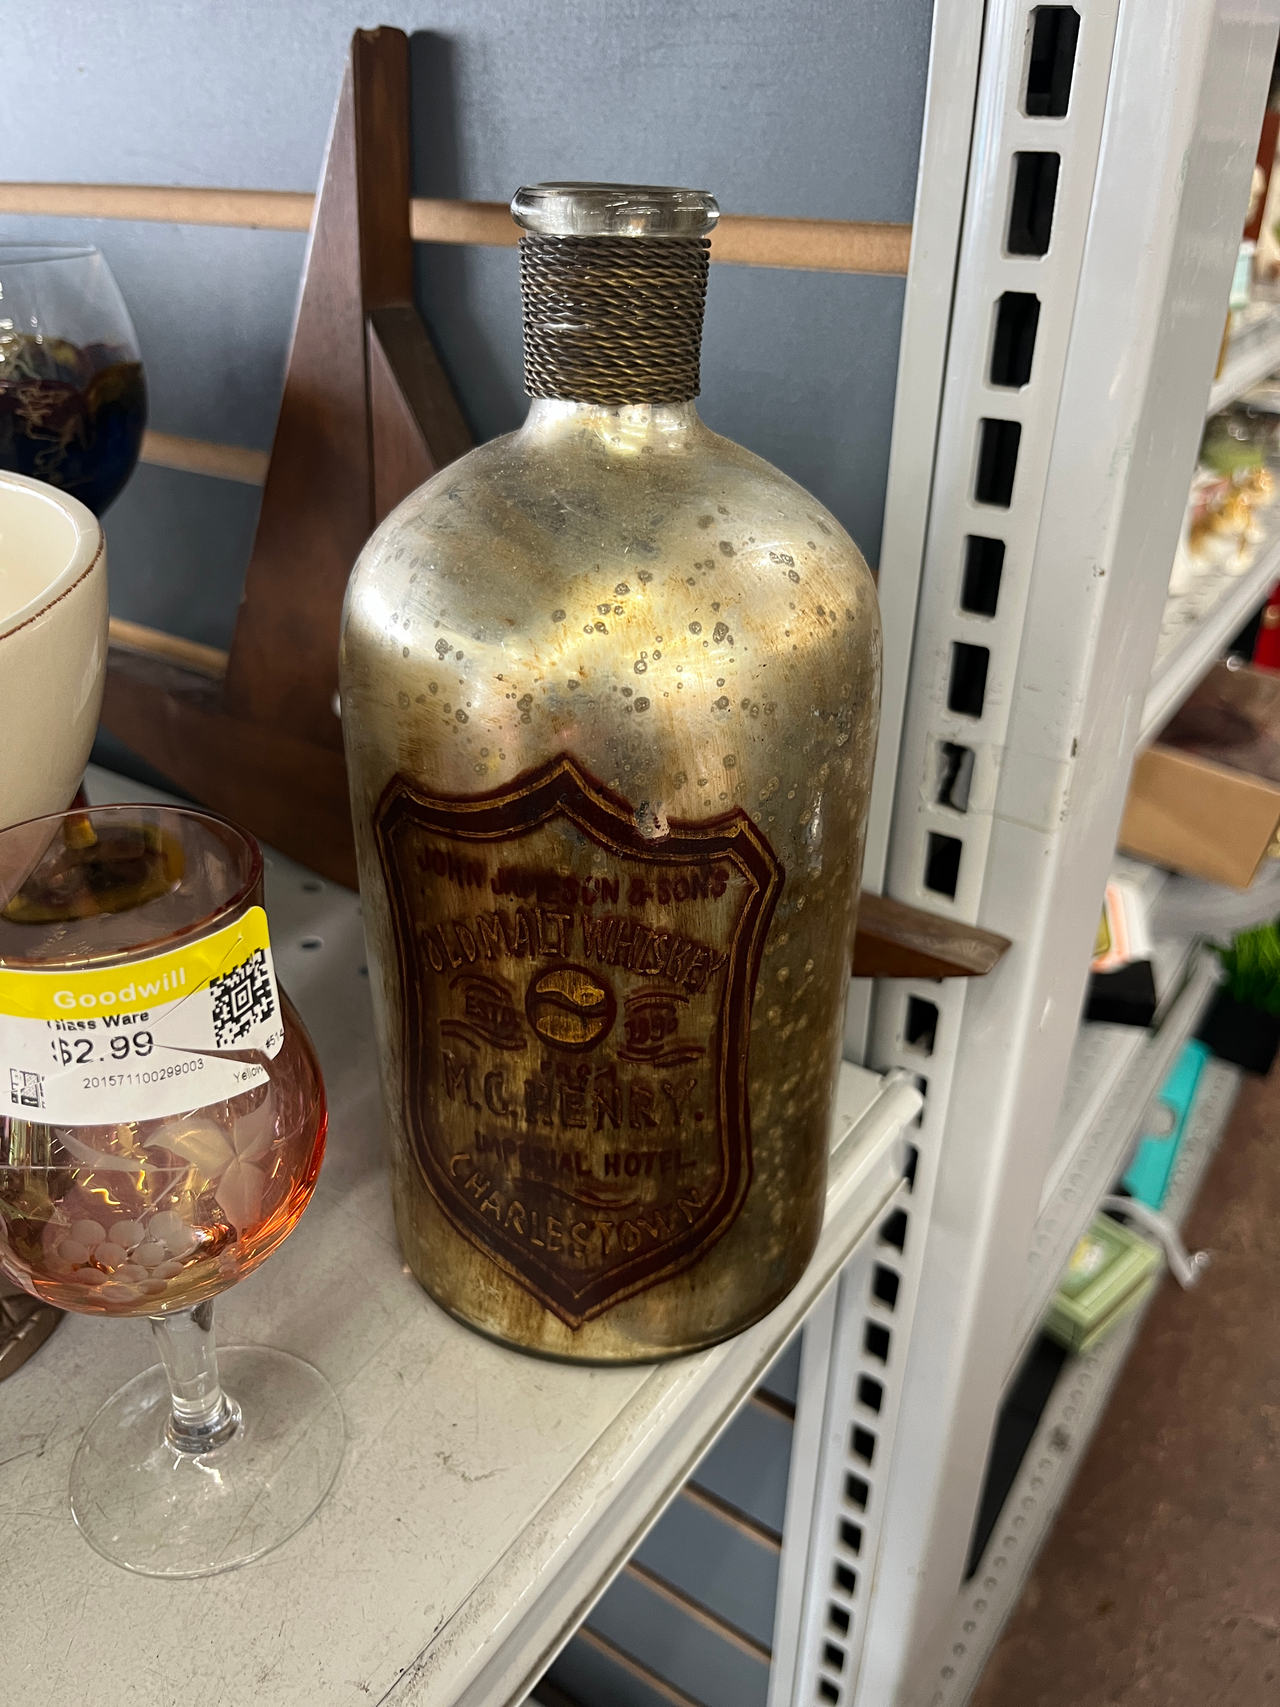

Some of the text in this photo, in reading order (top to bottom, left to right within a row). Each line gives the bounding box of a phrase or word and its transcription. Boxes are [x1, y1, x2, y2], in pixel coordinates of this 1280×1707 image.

[53, 967, 187, 1009] Goodwill
[102, 1011, 149, 1028] Ware
[51, 1030, 154, 1066] $2.99
[83, 1058, 205, 1090] 201571100299003
